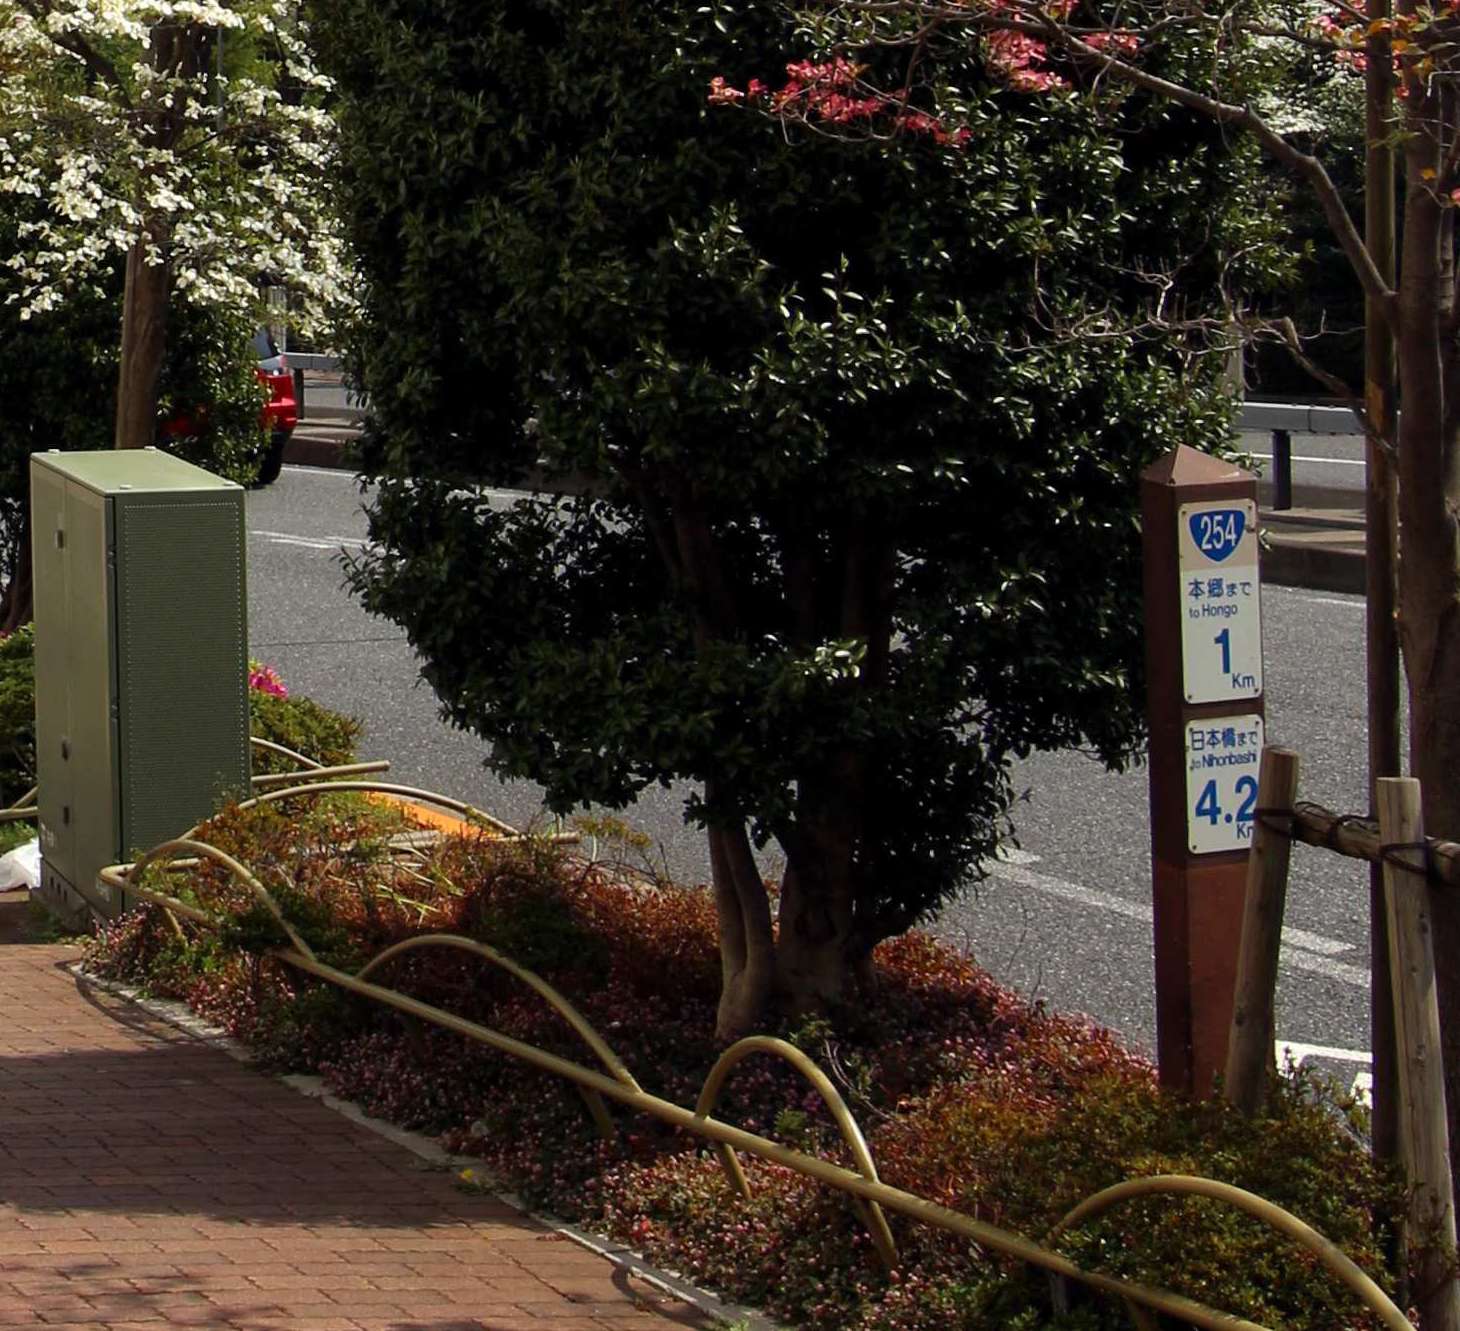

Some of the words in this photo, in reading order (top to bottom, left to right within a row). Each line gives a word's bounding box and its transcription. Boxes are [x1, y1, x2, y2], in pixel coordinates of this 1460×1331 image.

[1200, 514, 1237, 550] 254
[1187, 578, 1252, 600] 本郷まで
[1189, 607, 1200, 619] to
[1201, 603, 1238, 619] Hongo
[1214, 628, 1231, 675] 1
[1231, 673, 1256, 689] Km
[1191, 727, 1258, 751] 日本橋まで
[1202, 749, 1257, 768] Nihonbashi
[1195, 775, 1259, 826] 4.2
